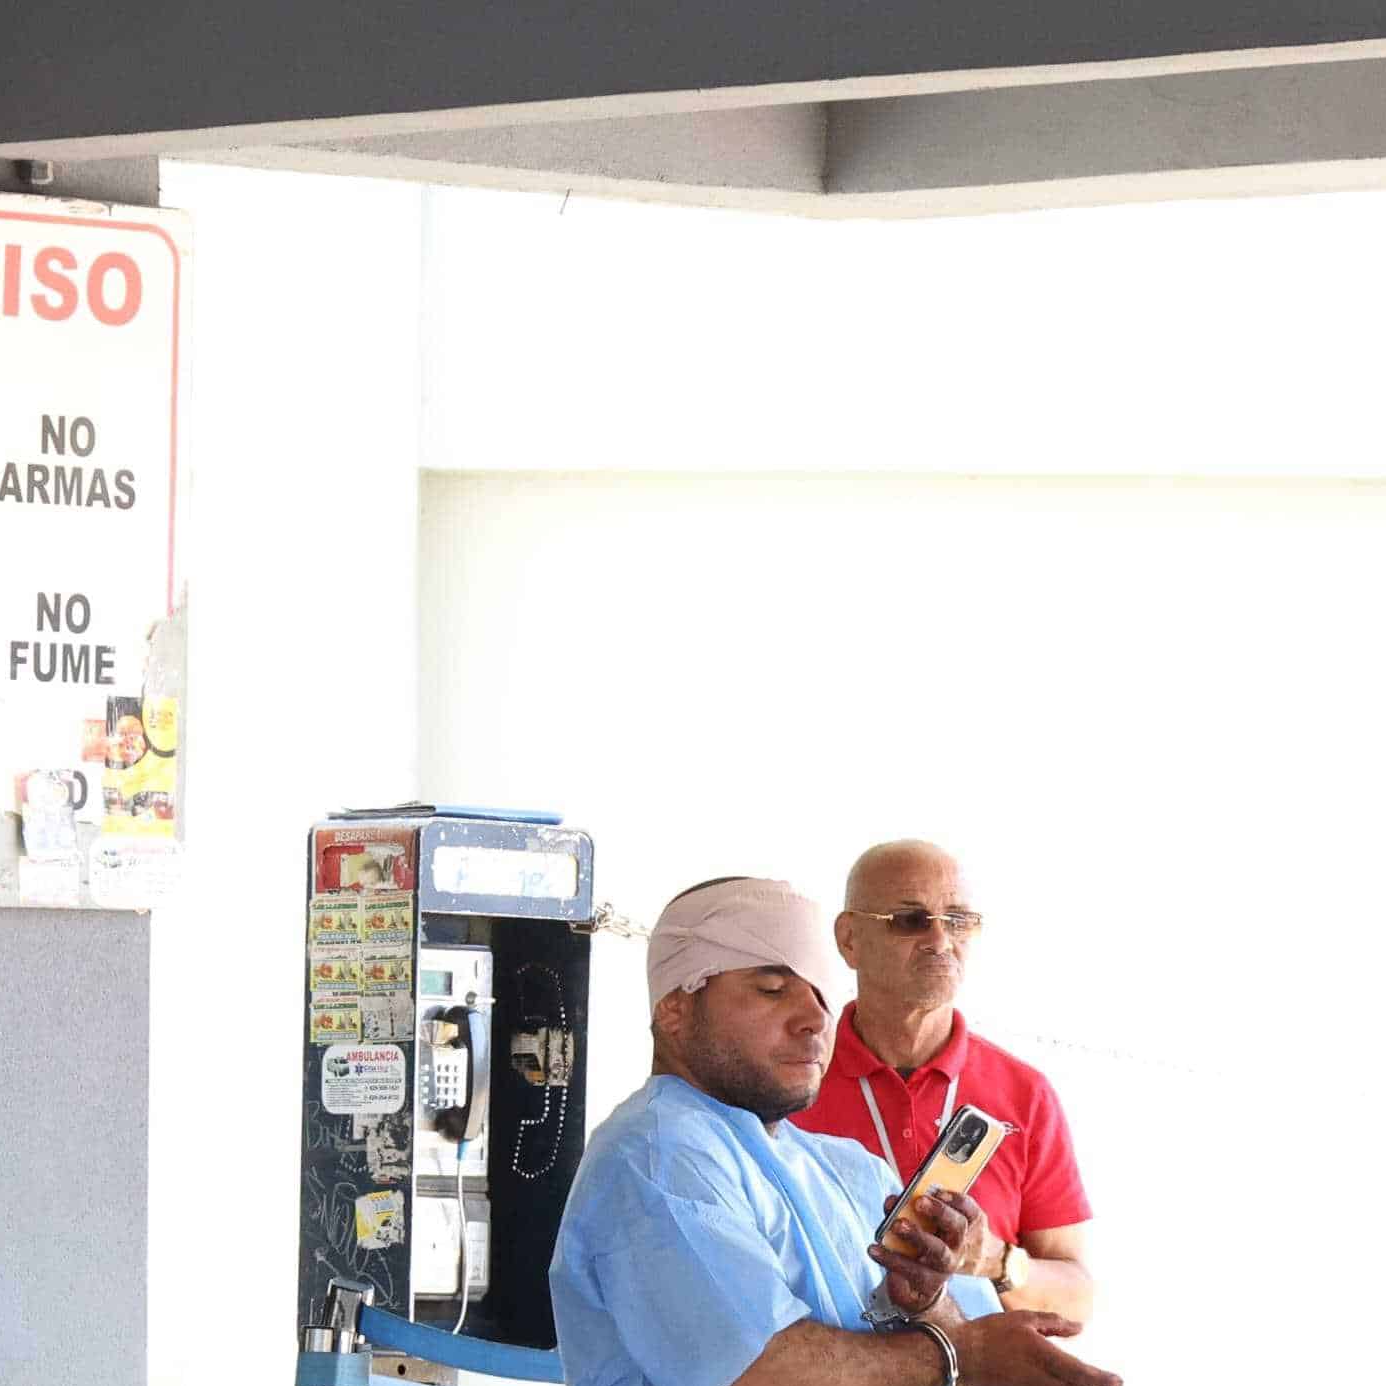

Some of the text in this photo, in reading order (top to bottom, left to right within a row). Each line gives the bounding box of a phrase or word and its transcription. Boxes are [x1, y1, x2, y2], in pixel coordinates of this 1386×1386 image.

[41, 414, 96, 457] NO
[36, 591, 91, 634] NO
[10, 640, 116, 685] FUME
[346, 1050, 399, 1062] AMBULANCIA
